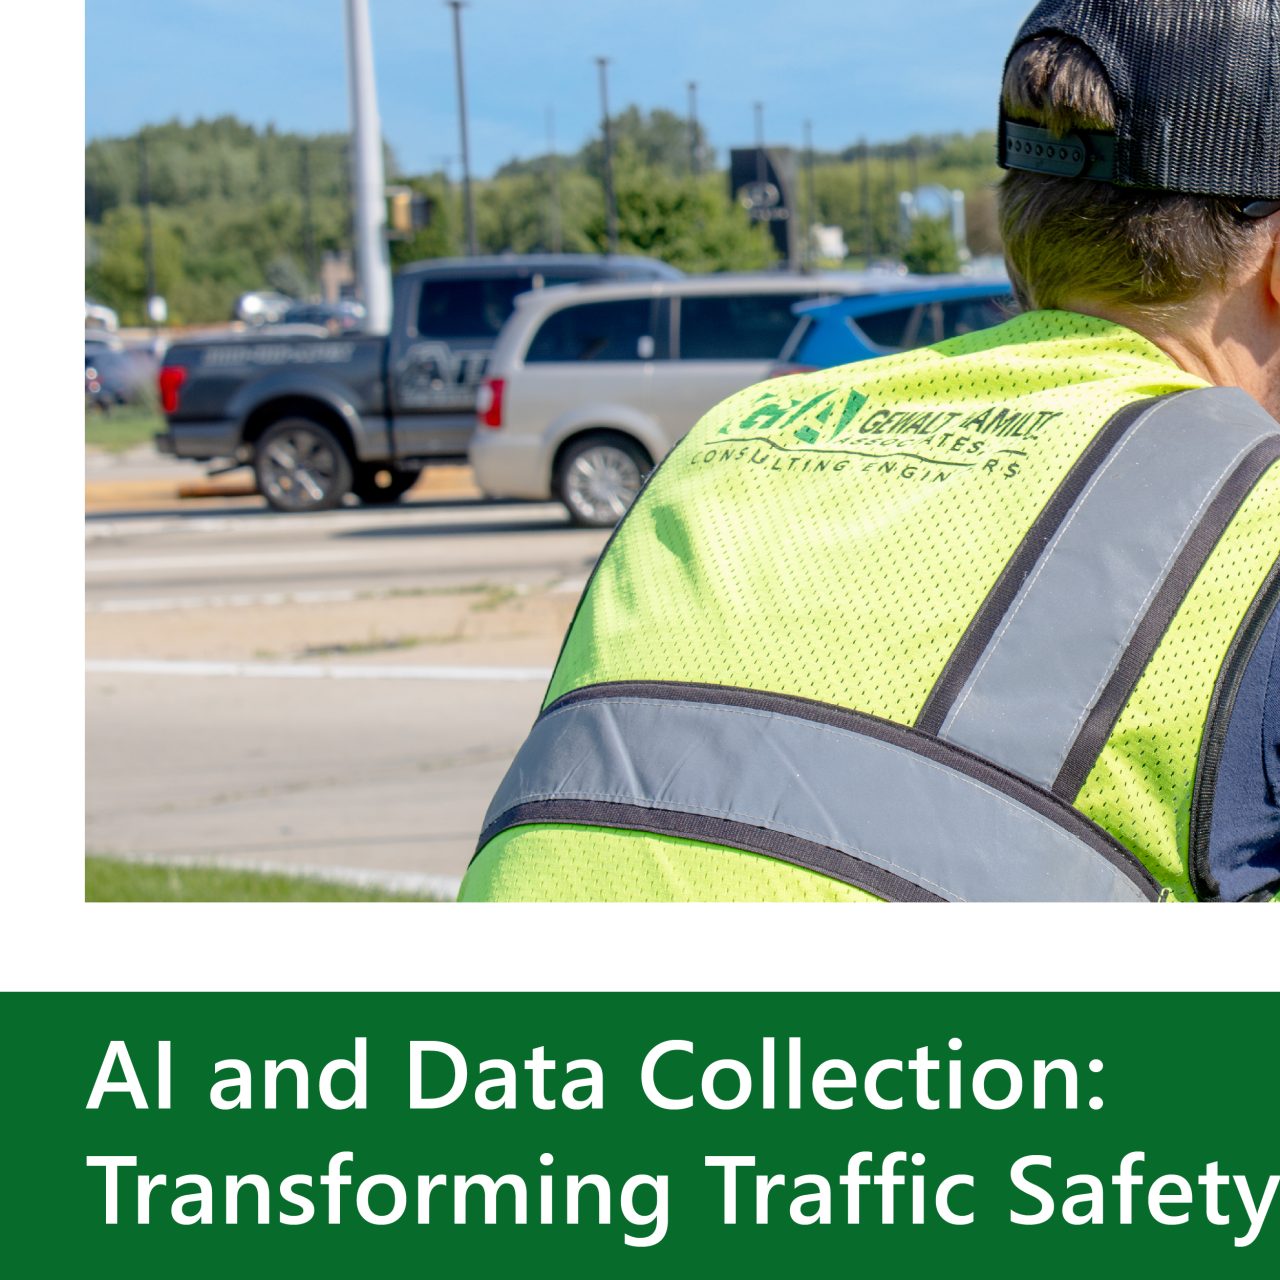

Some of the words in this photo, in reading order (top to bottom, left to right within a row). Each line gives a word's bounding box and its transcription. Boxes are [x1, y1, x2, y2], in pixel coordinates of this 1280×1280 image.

[858, 409, 963, 435] GEWALT
[690, 446, 851, 472] CONSULTING
[861, 458, 1021, 483] ENGINRS
